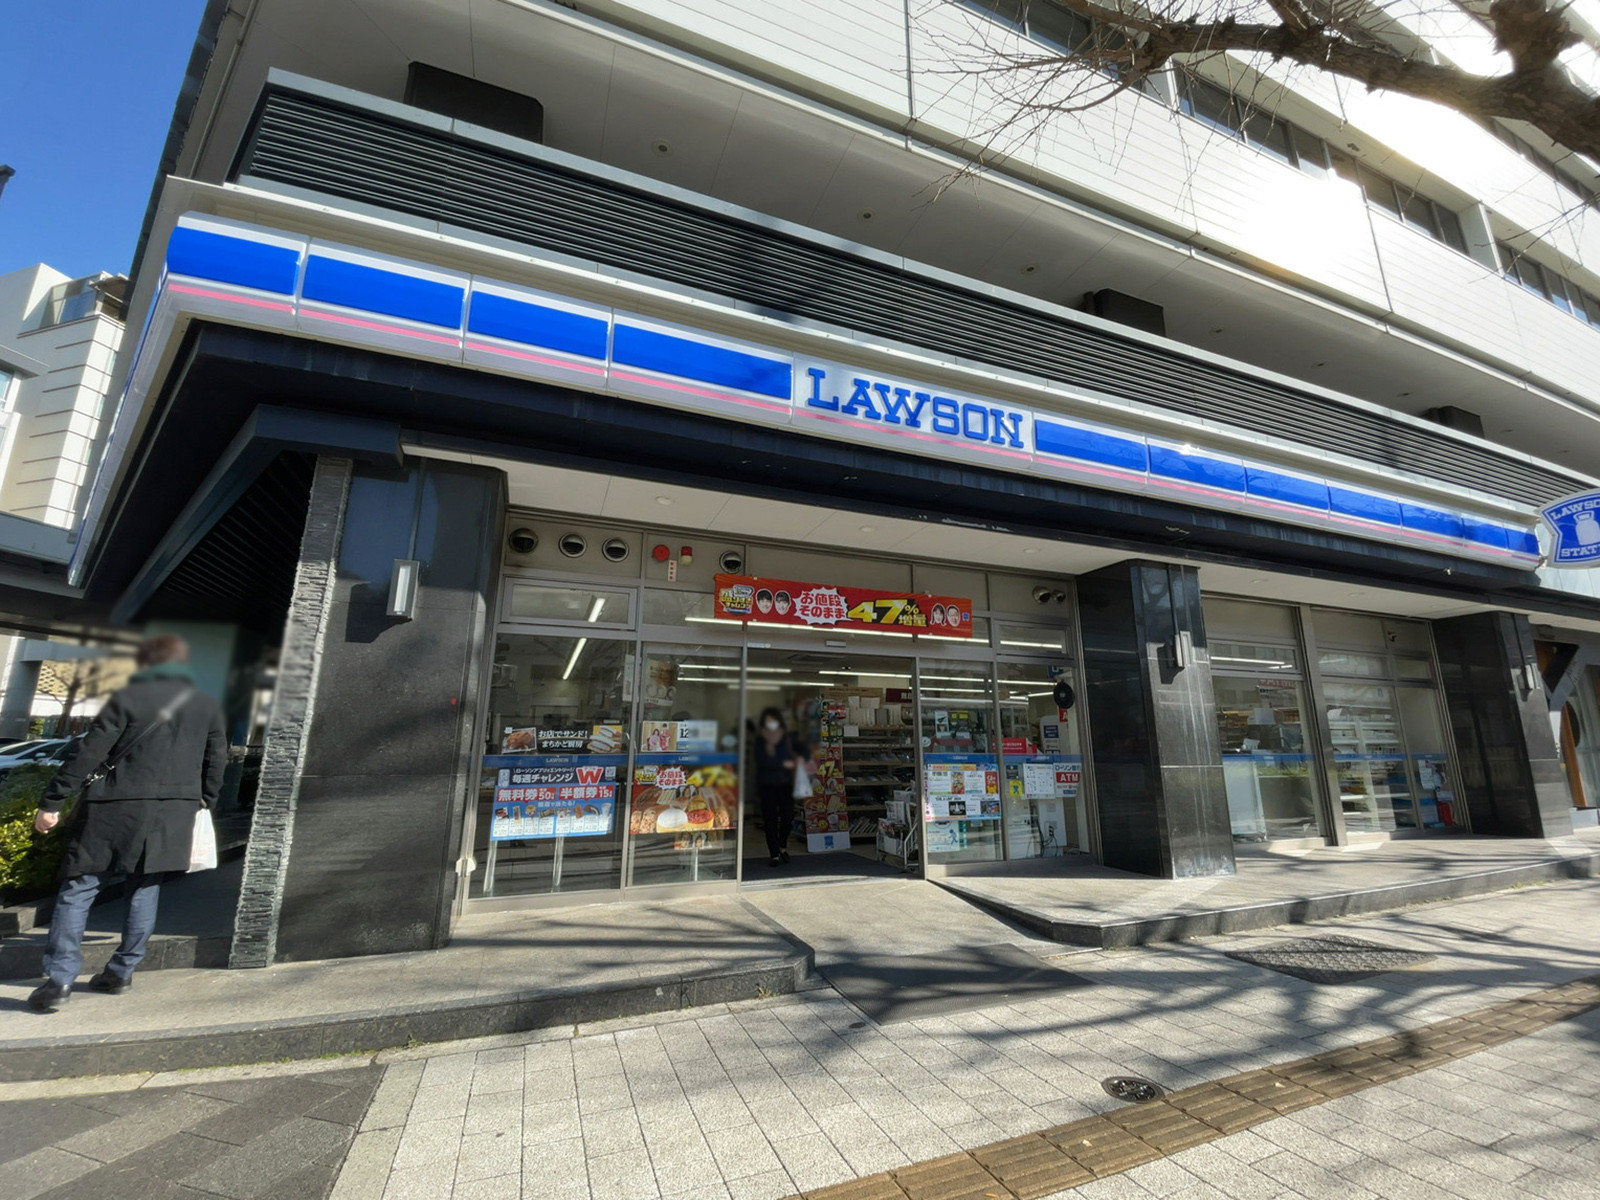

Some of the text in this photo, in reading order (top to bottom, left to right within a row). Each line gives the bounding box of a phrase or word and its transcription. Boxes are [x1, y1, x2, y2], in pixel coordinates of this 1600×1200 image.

[807, 367, 1024, 449] LAWSON
[801, 592, 842, 607] お値段
[799, 605, 846, 619] そのまま
[512, 773, 574, 784] 毎週チャレンジ
[1060, 773, 1079, 782] ATM
[498, 789, 538, 802] 無料券
[560, 787, 598, 799] 半額券
